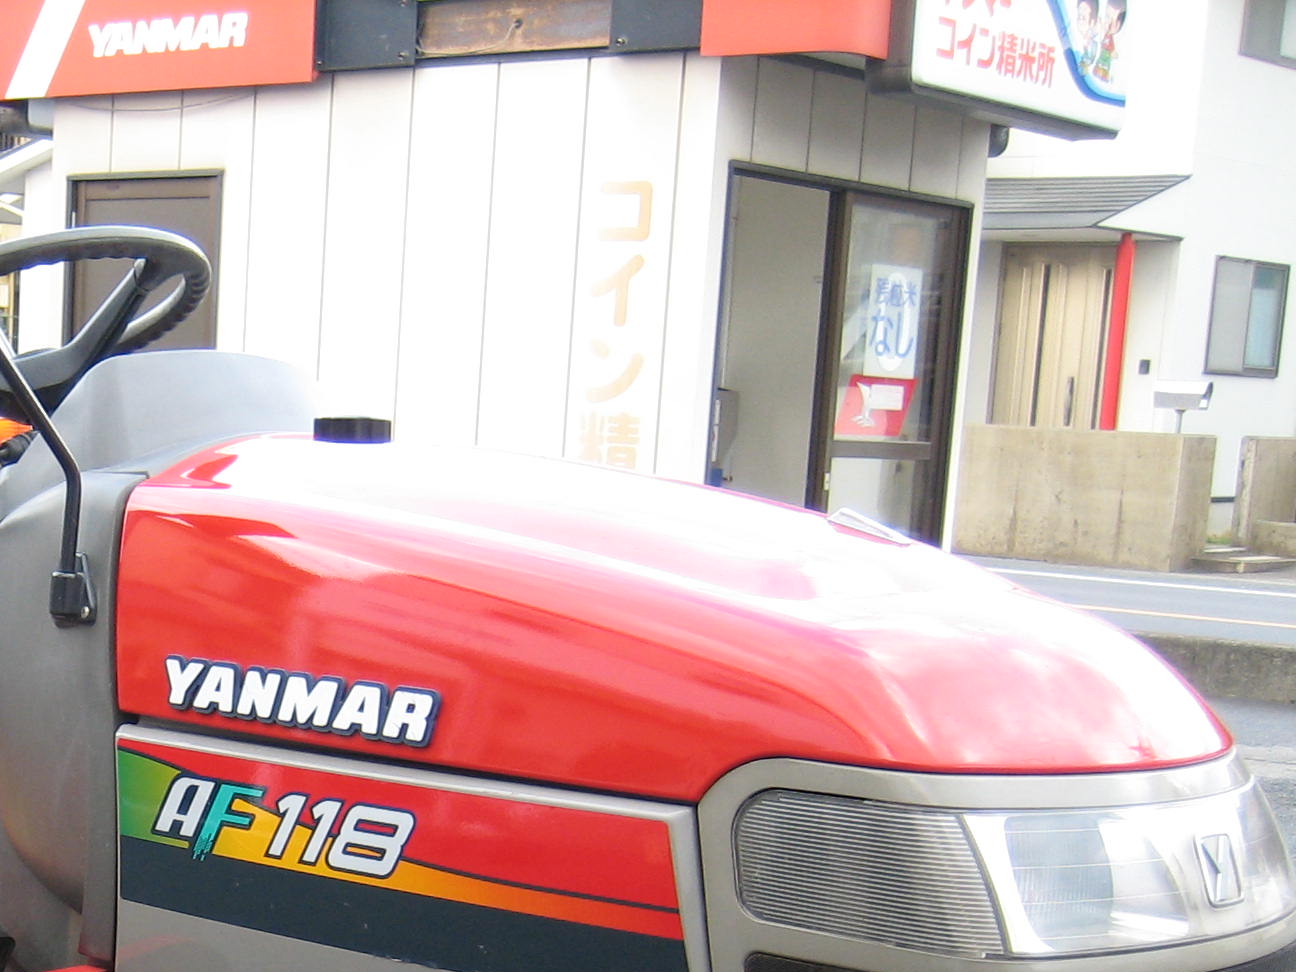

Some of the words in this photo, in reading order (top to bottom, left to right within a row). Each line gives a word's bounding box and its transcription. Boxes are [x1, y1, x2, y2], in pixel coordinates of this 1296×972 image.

[88, 12, 249, 58] YANMAR
[935, 16, 1056, 88] コイン精米所
[870, 310, 914, 359] なし
[165, 655, 438, 746] YANMAR
[152, 775, 415, 879] AF118
